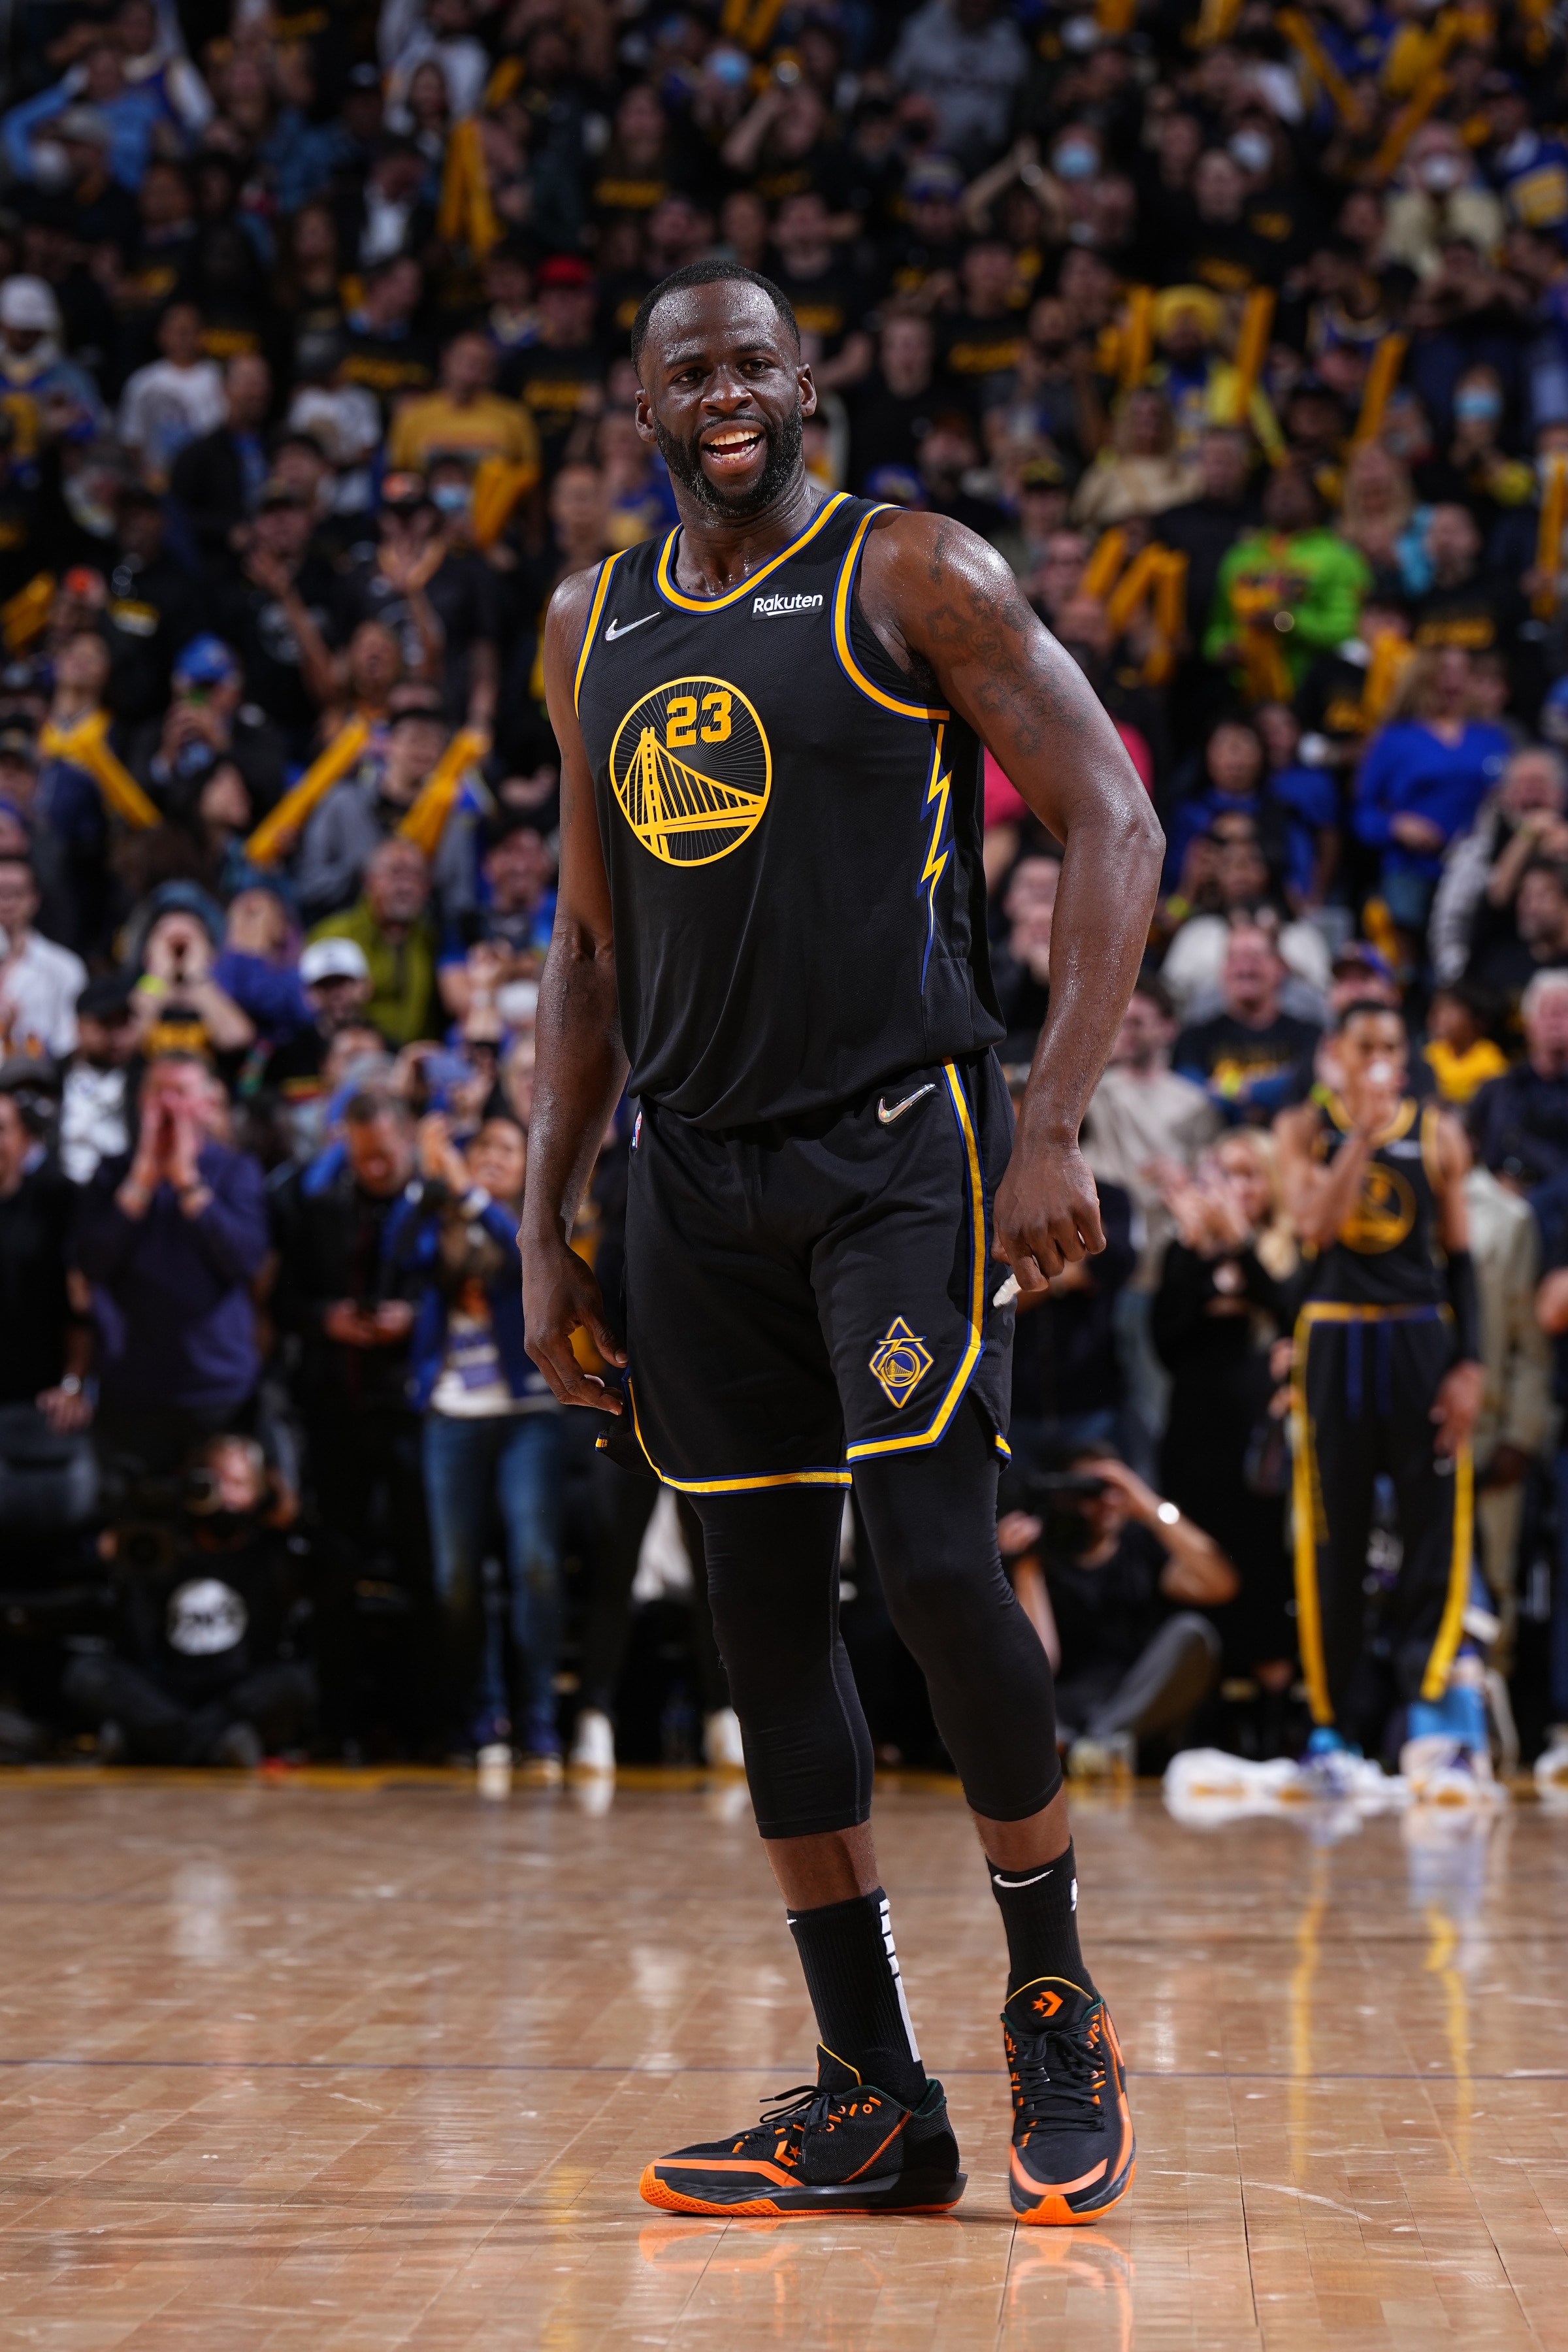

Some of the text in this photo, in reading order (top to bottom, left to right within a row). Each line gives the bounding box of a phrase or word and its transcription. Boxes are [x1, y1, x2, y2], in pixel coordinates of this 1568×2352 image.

[753, 594, 823, 613] Rakuten
[666, 691, 732, 749] 23
[877, 1337, 924, 1387] 75
